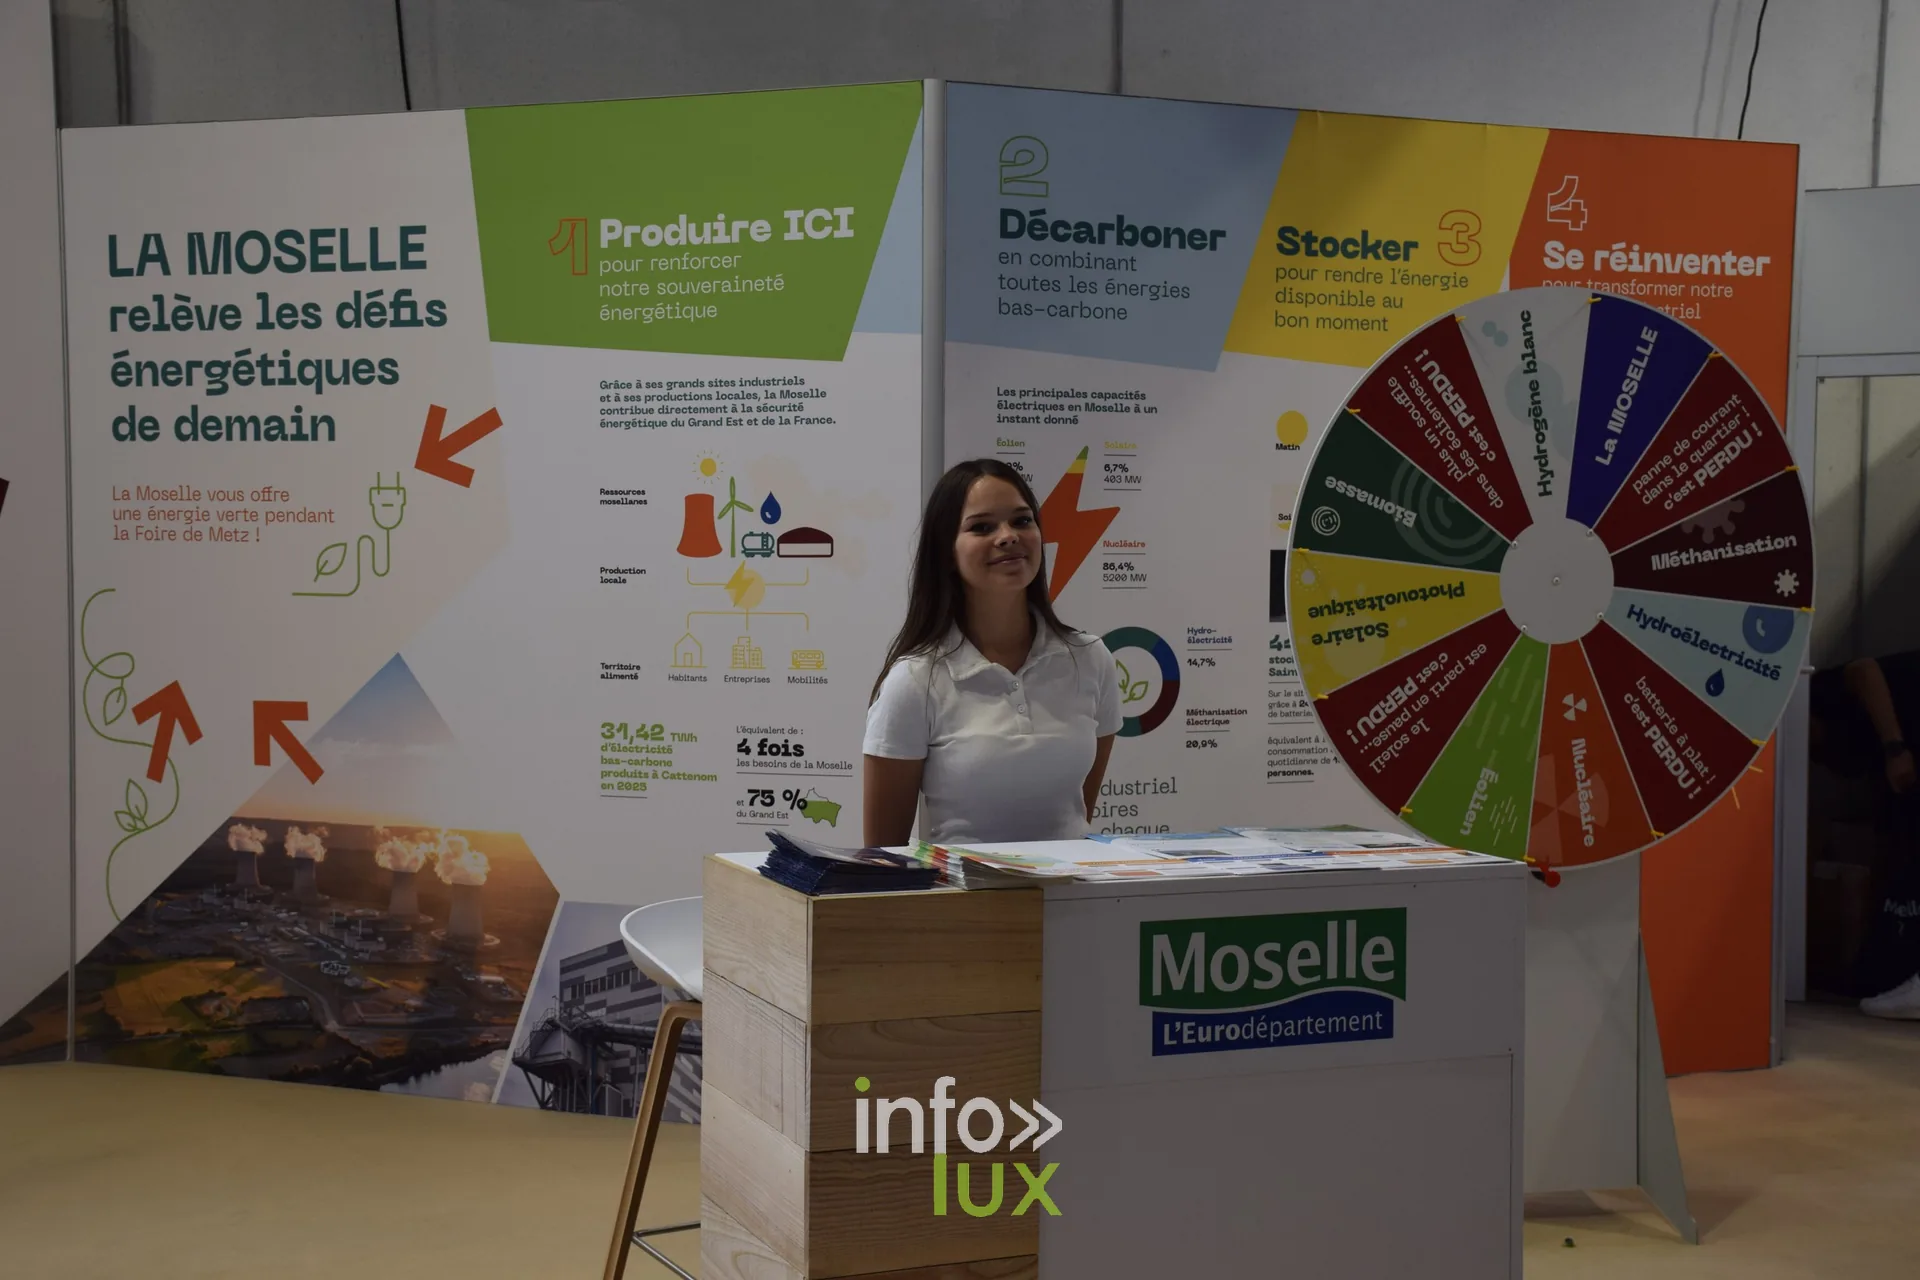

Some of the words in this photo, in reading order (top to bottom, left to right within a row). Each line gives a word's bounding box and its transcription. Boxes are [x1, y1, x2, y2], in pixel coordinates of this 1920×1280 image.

[999, 135, 1049, 198] 2
[1546, 173, 1588, 232] 4
[601, 213, 771, 248] Produire
[784, 207, 854, 240] ICI
[1000, 208, 1226, 251] Décarboner
[1438, 210, 1481, 266] 3
[109, 233, 171, 277] LA
[187, 225, 426, 275] MOSELLE
[548, 217, 588, 276] 1
[1276, 226, 1418, 264] Stocker
[600, 259, 643, 276] pour
[651, 252, 741, 271] renforcer
[999, 252, 1021, 265] en
[1030, 251, 1136, 271] combinant
[1543, 241, 1584, 270] Se
[1594, 242, 1770, 276] réinventer
[600, 281, 649, 296] notre
[657, 274, 784, 295] souveraineté
[998, 274, 1061, 292] toutes
[1068, 275, 1097, 294] les
[1105, 278, 1190, 301] énergies
[1276, 267, 1318, 283] pour
[1325, 267, 1383, 284] rendre
[1390, 268, 1468, 291] l'énergie
[1587, 279, 1684, 297] transformer
[1691, 284, 1733, 297] notre
[999, 297, 1127, 320] bas-carbone
[1275, 287, 1375, 308] disponible
[1382, 296, 1403, 308] au
[110, 293, 242, 332] relève
[256, 292, 322, 330] les
[336, 289, 447, 329] défis
[600, 302, 717, 323] énergétique
[1275, 310, 1308, 328] bon
[1316, 315, 1389, 332] moment
[1520, 310, 1538, 375] blanc
[111, 348, 399, 396] énergétiques
[600, 380, 632, 389] Grâce
[666, 379, 705, 391] grands
[708, 378, 736, 387] sites
[739, 376, 805, 387] industriels
[645, 392, 712, 404] productions
[716, 390, 760, 402] locales,
[780, 388, 826, 399] Moselle
[1019, 388, 1087, 400] principales
[1091, 391, 1146, 401] capacités
[1387, 376, 1427, 428] souffle
[1420, 363, 1474, 428] PERDU
[1595, 437, 1618, 466] La
[1607, 325, 1659, 434] MOSELLE
[600, 406, 654, 415] contribue
[658, 405, 728, 414] directement
[741, 403, 753, 413] la
[756, 402, 804, 413] sécurité
[997, 400, 1065, 413] électriques
[1085, 402, 1130, 413] Moselle
[112, 405, 160, 442] de
[174, 405, 335, 442] demain
[600, 418, 667, 430] énergétique
[688, 417, 722, 427] Grand
[794, 416, 836, 425] France.
[997, 414, 1040, 424] instant
[1044, 414, 1078, 424] donné
[997, 437, 1025, 447] Éolien
[1425, 426, 1440, 446] un
[1469, 428, 1496, 462] c'est
[1528, 380, 1554, 496] Hydrogène
[1632, 455, 1673, 494] panne
[1673, 438, 1690, 456] de
[1692, 393, 1741, 440] courant
[1104, 464, 1128, 473] 6,7%
[1439, 449, 1466, 482] plus
[1459, 449, 1479, 477] les
[1642, 475, 1674, 505] dans
[1672, 462, 1689, 478] le
[1690, 416, 1740, 464] quartier
[1663, 480, 1696, 510] c'est
[1693, 429, 1753, 487] PERDU
[1104, 475, 1122, 483] 403
[113, 486, 131, 501] La
[137, 485, 201, 501] Moselle
[207, 490, 244, 502] vous
[251, 486, 289, 502] offre
[1325, 476, 1418, 528] Biomasse
[1477, 473, 1504, 509] dans
[113, 510, 141, 520] une
[148, 506, 210, 524] énergie
[216, 508, 258, 522] verte
[265, 507, 334, 526] pendant
[113, 525, 129, 540] la
[136, 526, 176, 541] Foire
[183, 526, 203, 541] de
[209, 526, 249, 542] Metz
[1651, 536, 1797, 570] Méthanisation
[600, 576, 626, 584] locale
[1308, 581, 1465, 618] Photovoltaïque
[1187, 627, 1216, 636] Hydro-
[1187, 636, 1232, 644] électricité
[1312, 622, 1389, 646] Solaire
[1627, 604, 1782, 680] Hydroélectricité
[1465, 643, 1487, 661] est
[601, 672, 638, 680] alimenté
[668, 674, 707, 682] Habitants
[724, 675, 770, 684] Entreprises
[1416, 652, 1448, 684] c'est
[1430, 661, 1464, 698] parti
[788, 676, 828, 684] Mobilités
[1186, 708, 1247, 716] Méthanisation
[1356, 678, 1419, 736] PERDU
[1412, 694, 1429, 710] en
[1635, 676, 1678, 735] batterie
[601, 722, 664, 745] 31,42
[737, 726, 785, 734] L'équivalent
[1186, 718, 1229, 726] électrique
[1411, 719, 1430, 735] le
[601, 743, 673, 754] d'électricité
[737, 738, 751, 755] 4
[758, 738, 804, 757] fois
[1268, 736, 1311, 746] équivalent
[1268, 746, 1328, 755] consommation
[1624, 693, 1651, 727] c'est
[1644, 724, 1696, 789] PERDU
[601, 755, 672, 767] bas-carbone
[753, 759, 787, 768] besoins
[817, 761, 852, 770] Moselle
[1267, 757, 1318, 767] quotidienne
[1369, 734, 1411, 774] soleil
[1682, 746, 1710, 778] plat
[601, 769, 649, 779] produits
[661, 771, 717, 781] Cattenom
[1267, 770, 1314, 779] personnes.
[748, 789, 775, 807] 75
[1460, 767, 1499, 835] Éolien
[1571, 738, 1596, 847] Nucléaire
[749, 810, 773, 819] Grand
[777, 810, 789, 820] Est
[1153, 920, 1394, 996] Moselle
[1164, 1011, 1382, 1045] L'Eurodépartement
